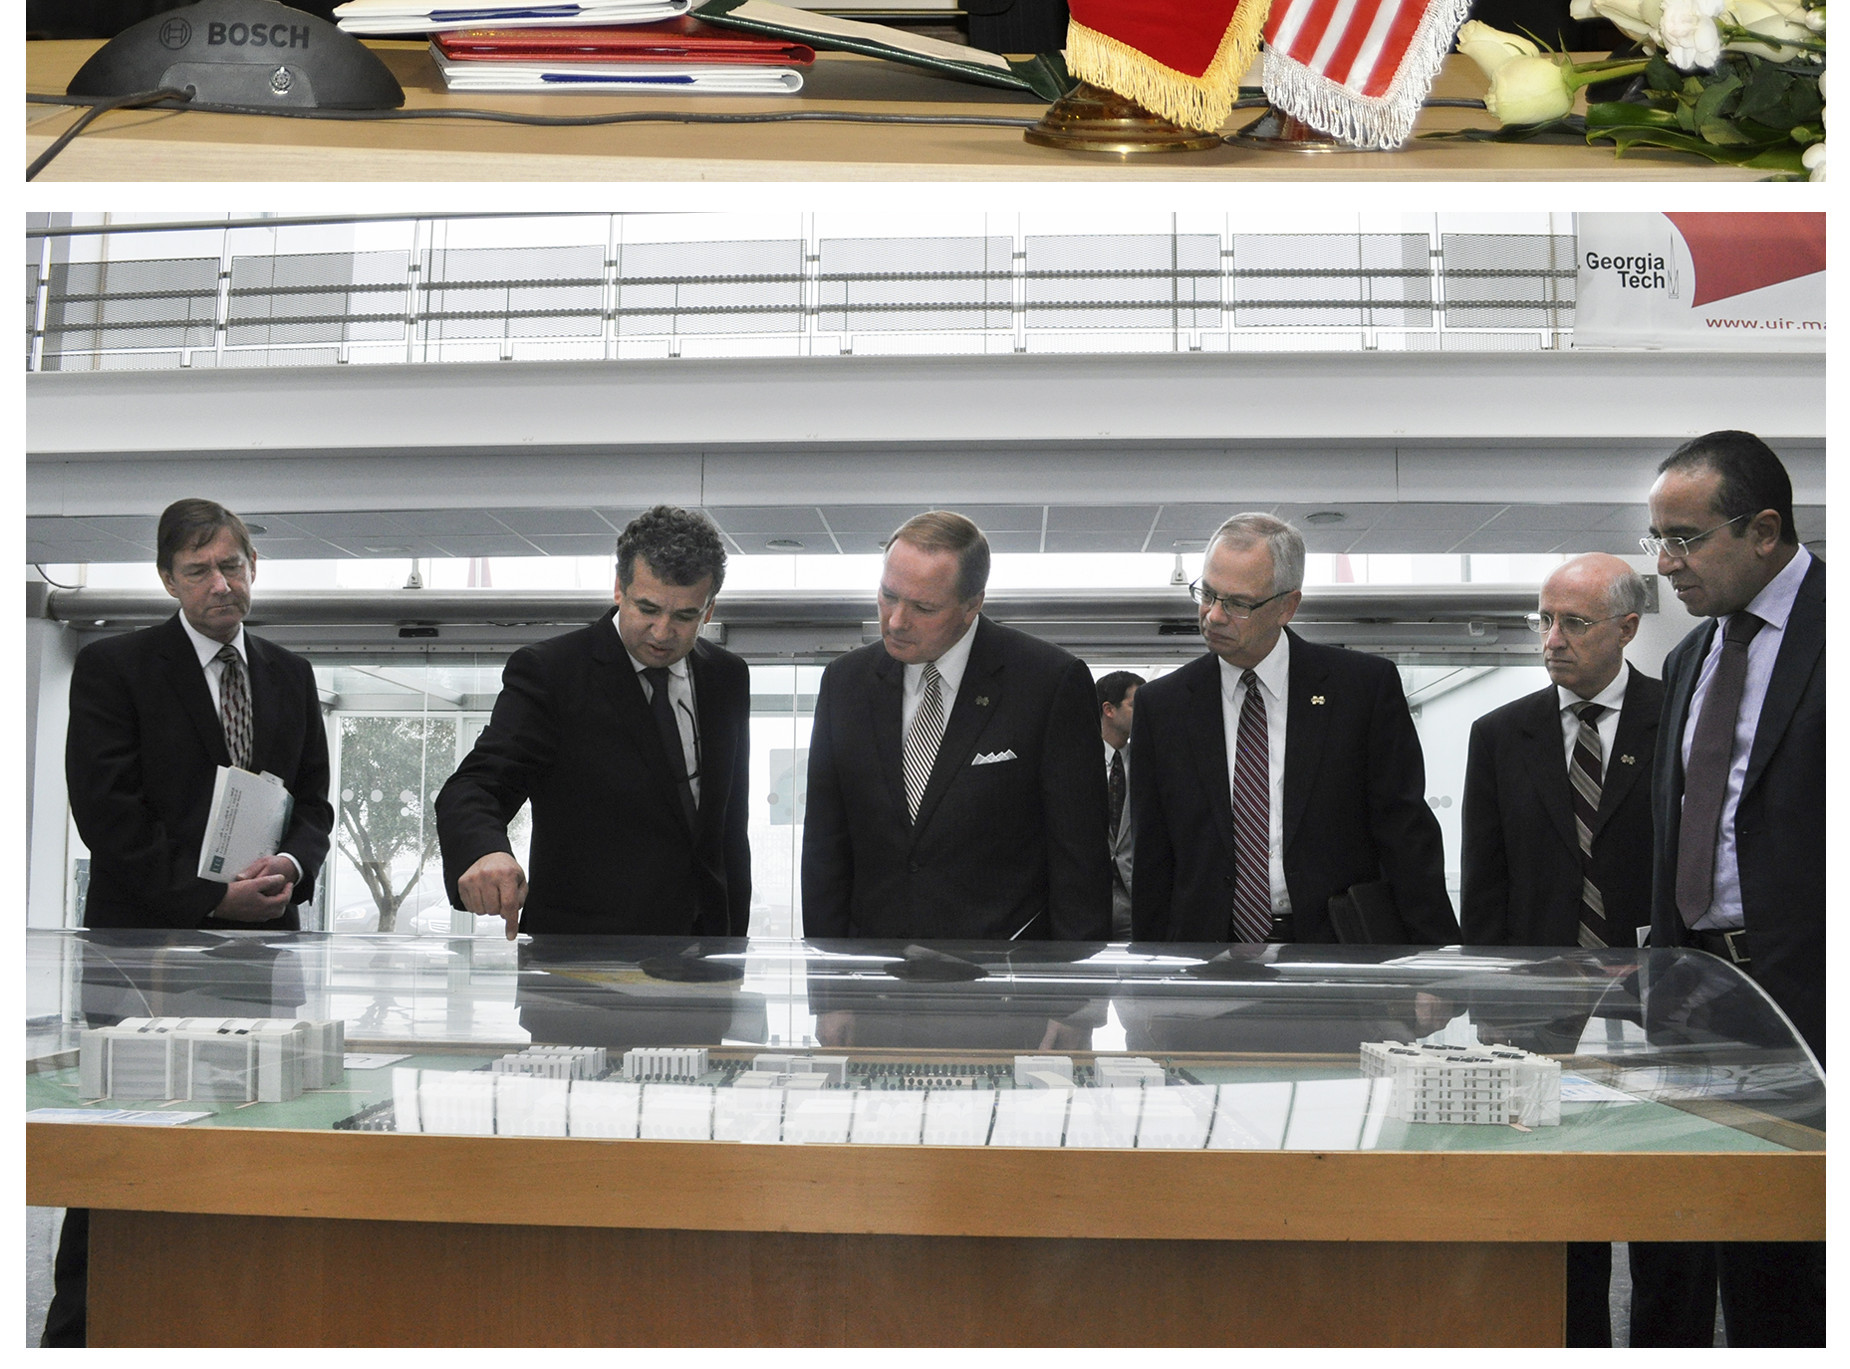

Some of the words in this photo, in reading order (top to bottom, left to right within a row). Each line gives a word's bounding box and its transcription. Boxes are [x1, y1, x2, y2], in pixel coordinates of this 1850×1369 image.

[208, 22, 309, 49] BOSCH
[1586, 252, 1665, 275] Georgia
[1617, 270, 1666, 289] Tech
[1705, 318, 1827, 331] www.uir.m
